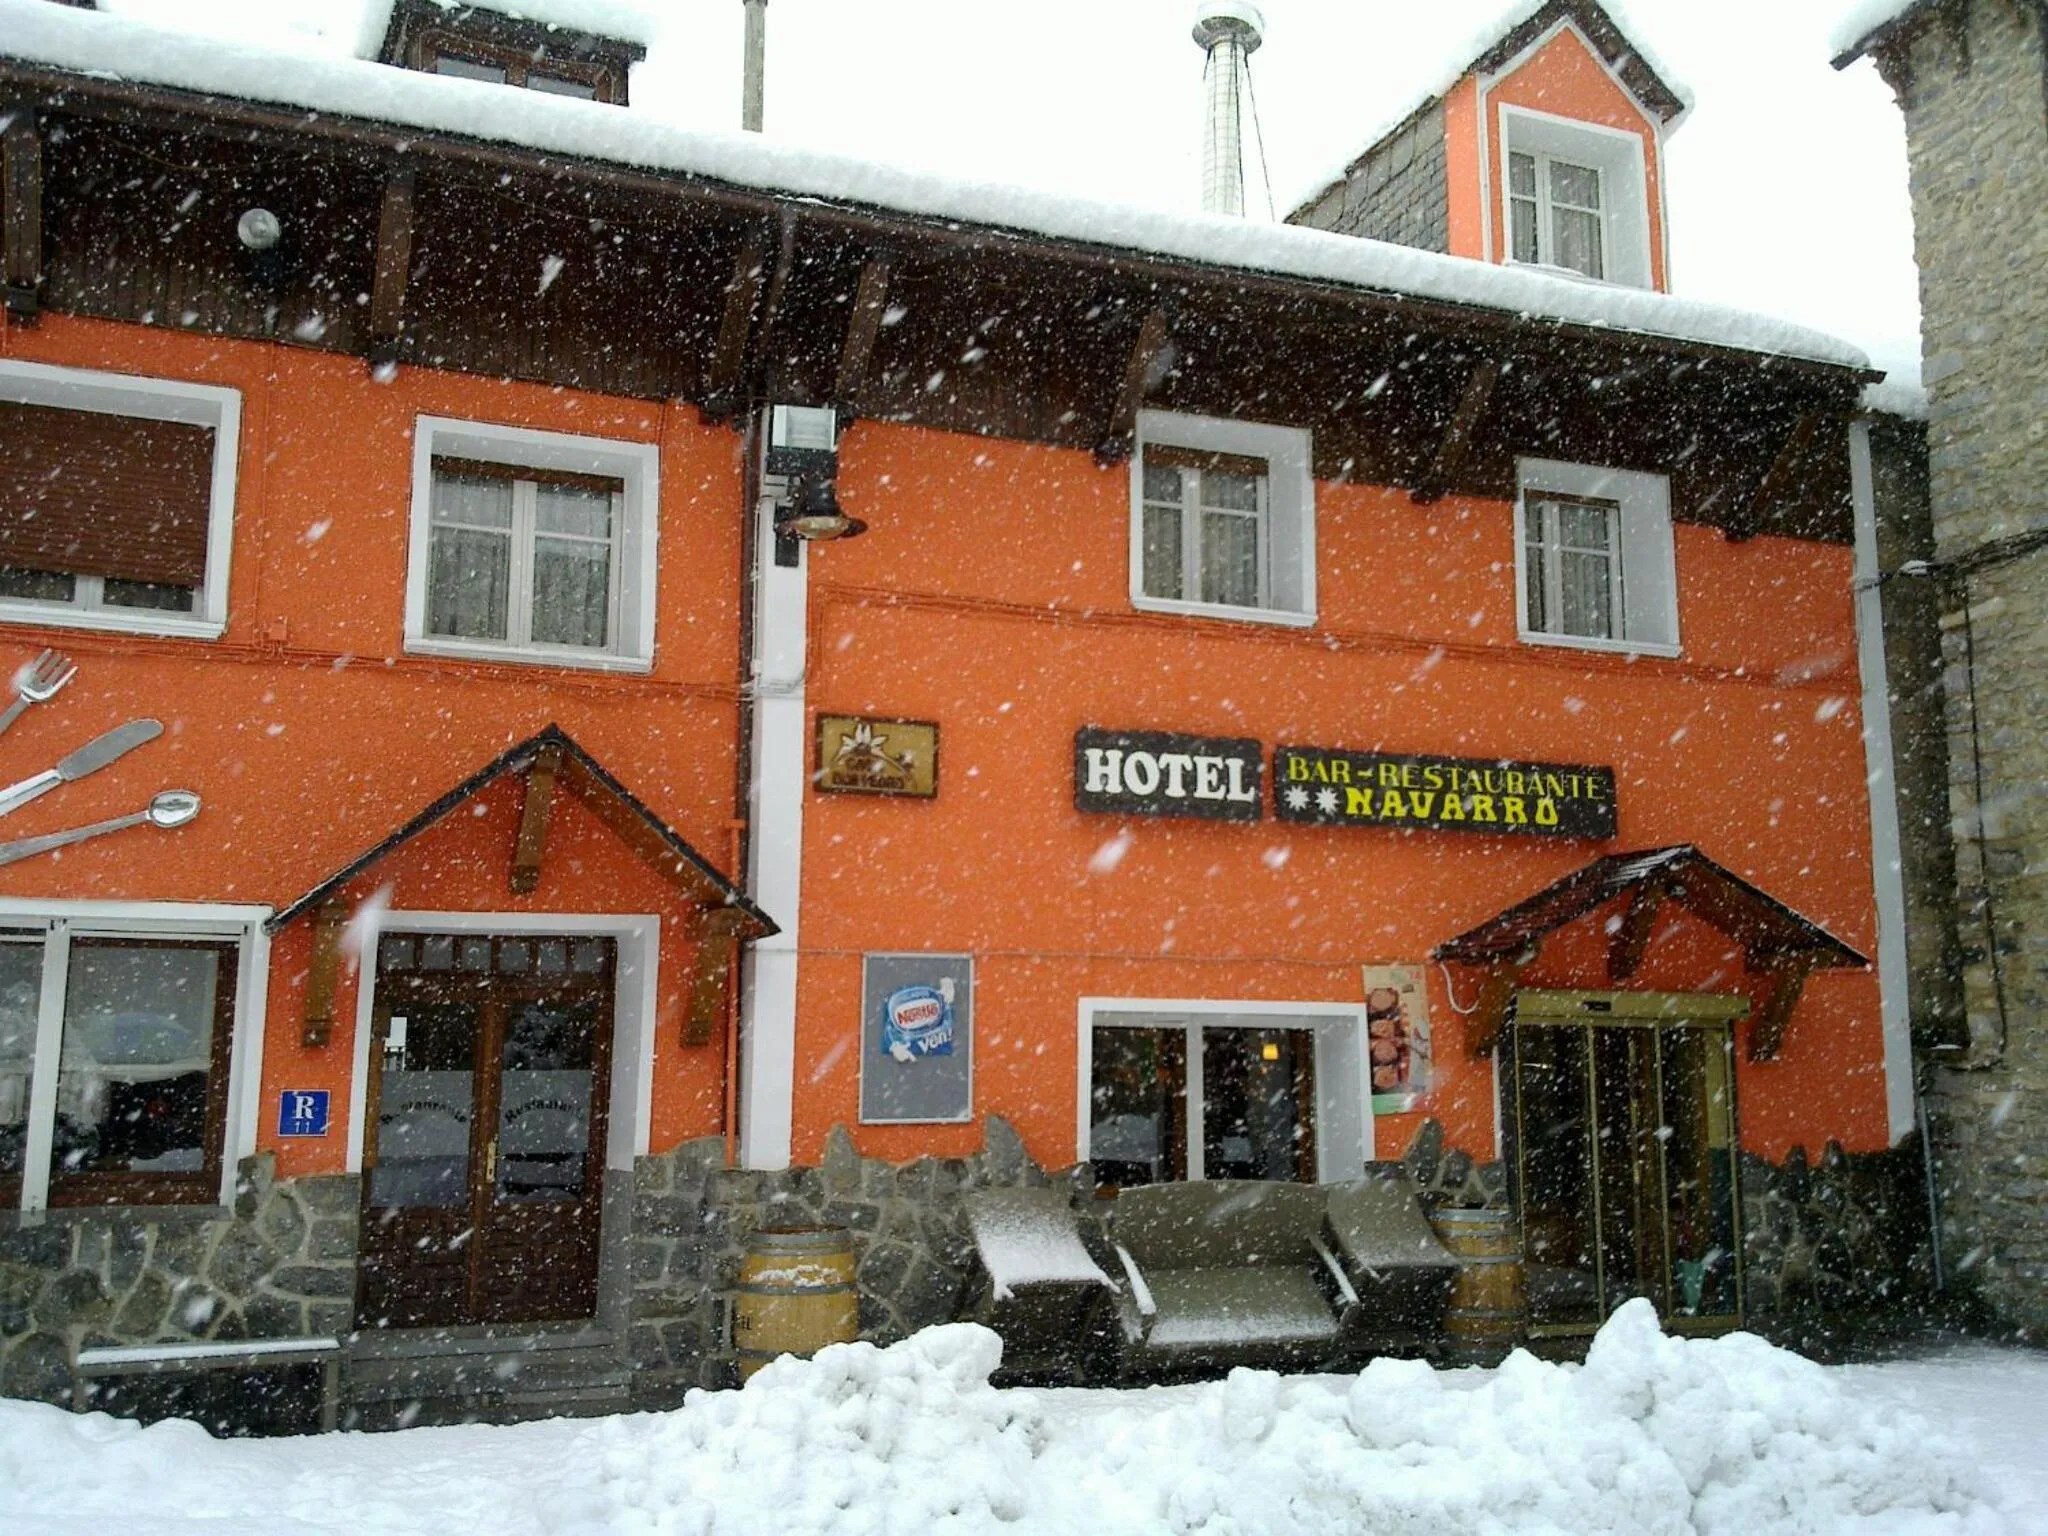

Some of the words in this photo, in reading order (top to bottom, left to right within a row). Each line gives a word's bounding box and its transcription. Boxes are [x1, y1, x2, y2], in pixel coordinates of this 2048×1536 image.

[1084, 748, 1255, 802] HOTEL
[1344, 786, 1560, 826] NAVARRO
[292, 1095, 315, 1119] R
